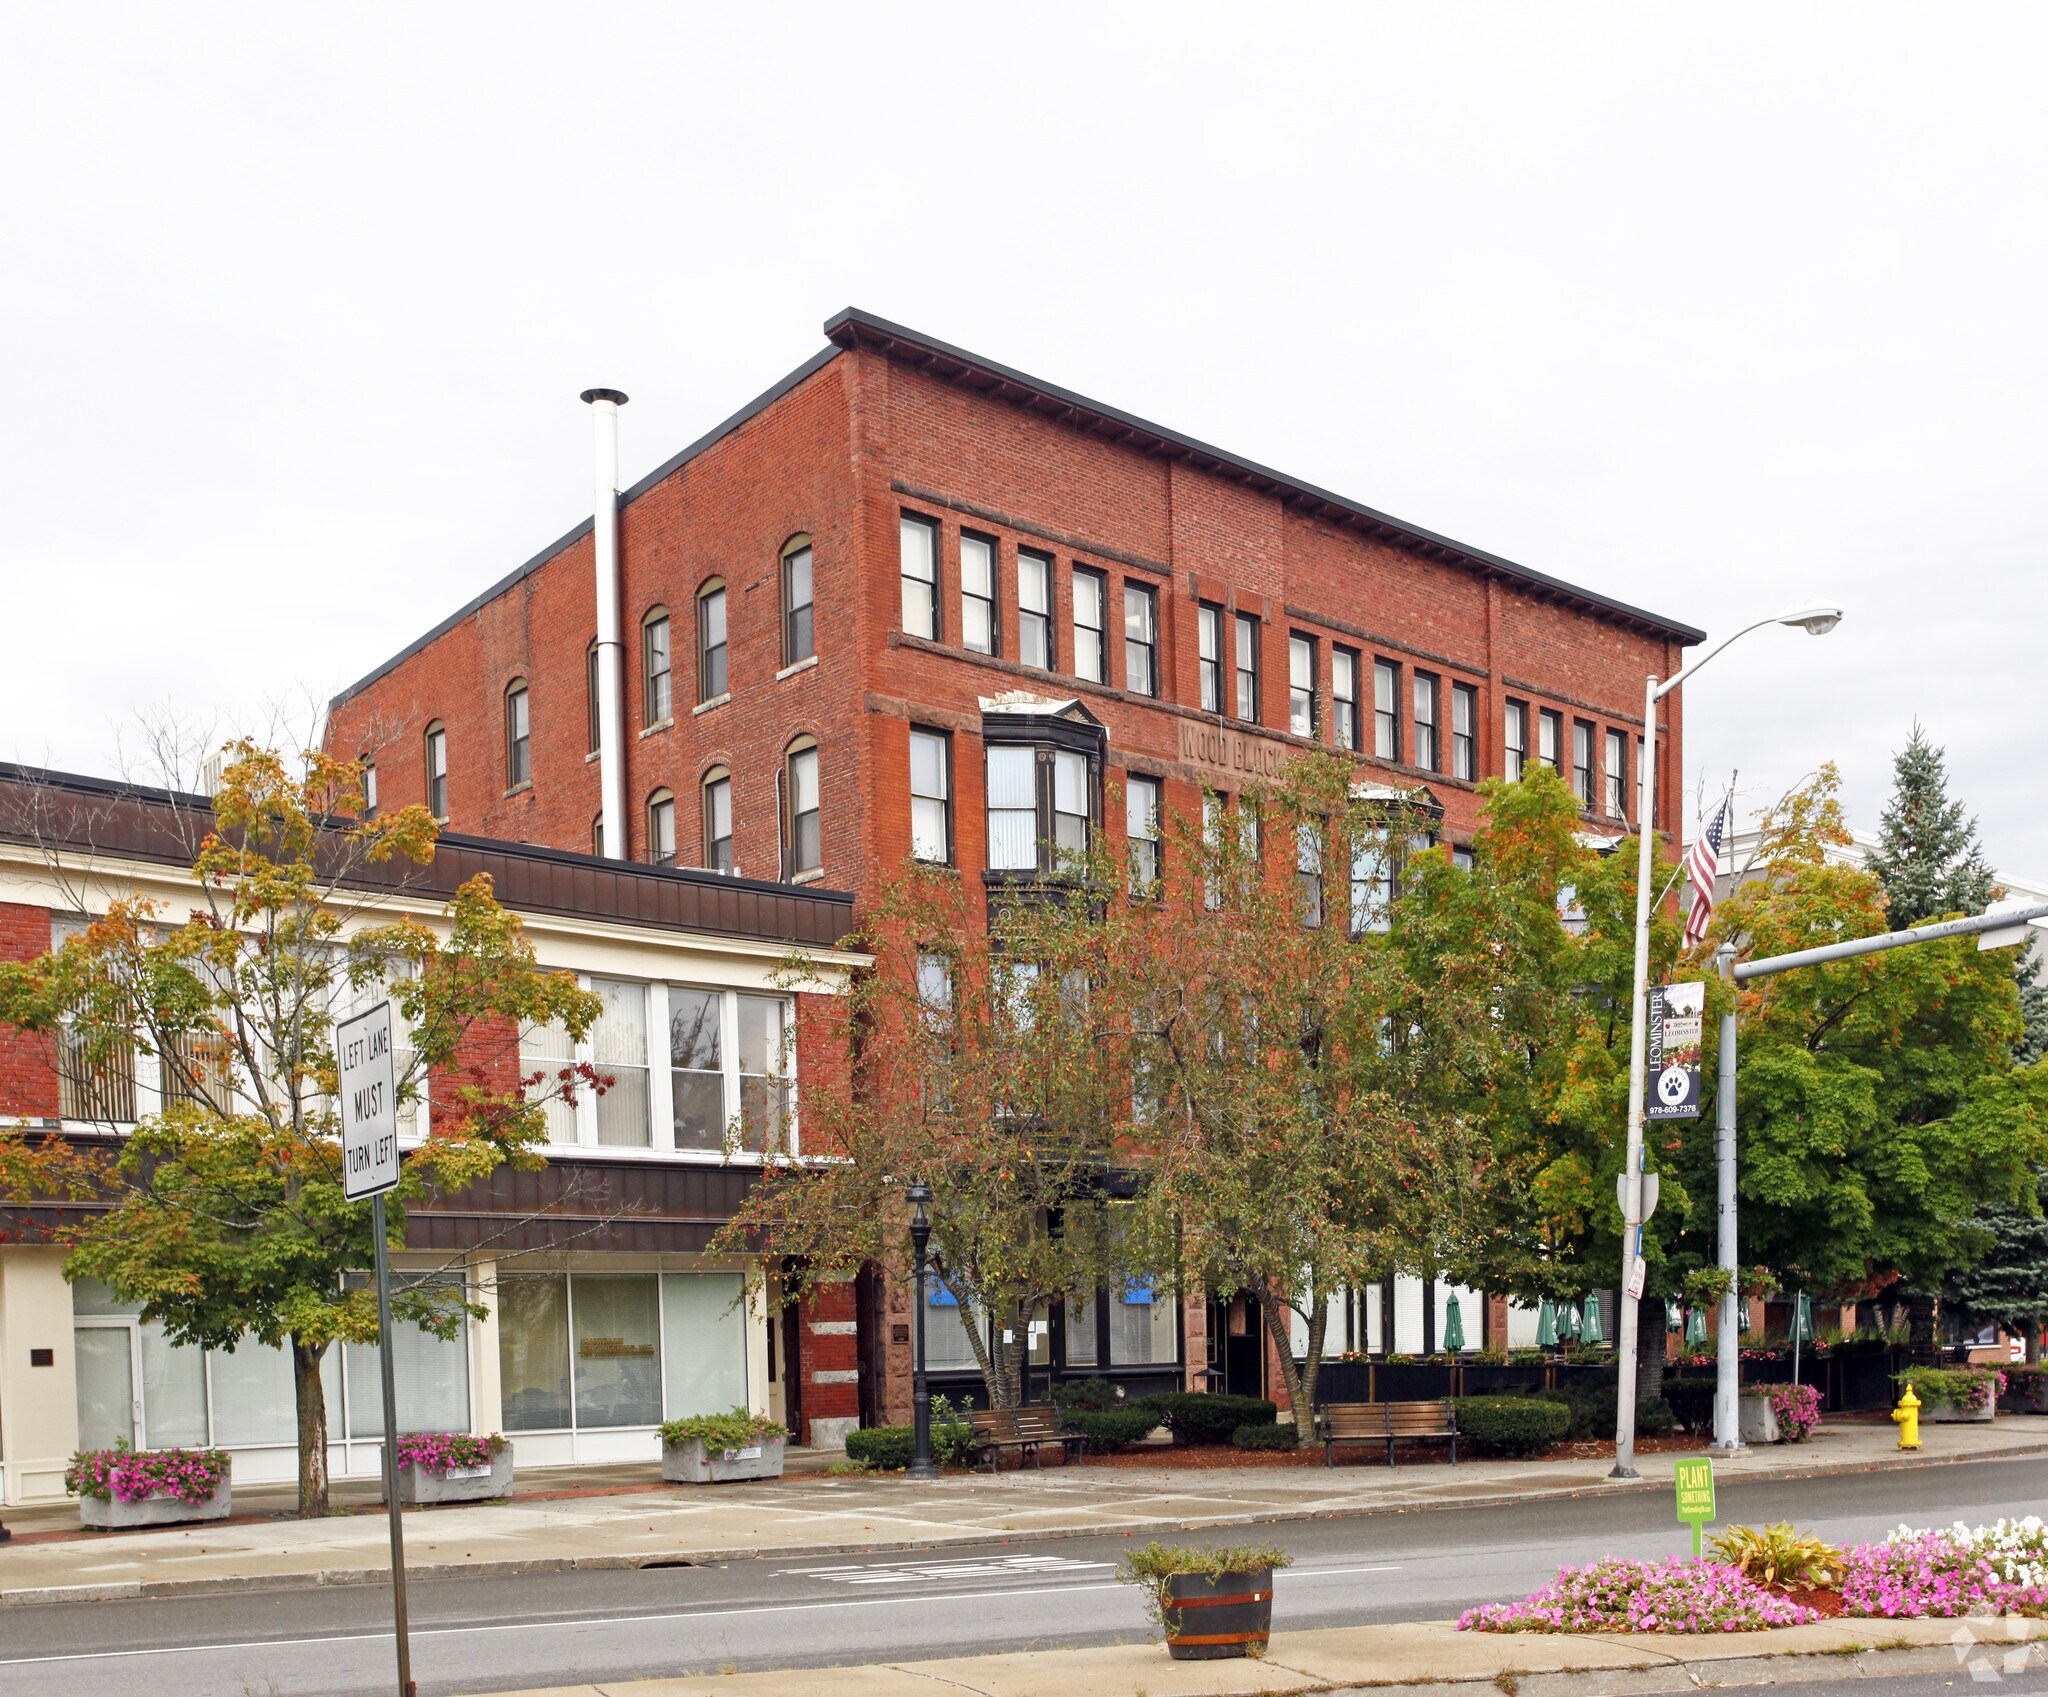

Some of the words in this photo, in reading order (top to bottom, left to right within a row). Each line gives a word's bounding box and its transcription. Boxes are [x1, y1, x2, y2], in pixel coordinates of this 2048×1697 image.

[1181, 725, 1227, 766] WOOD
[1233, 740, 1284, 780] BLOCK
[343, 1039, 364, 1071] LEFT
[368, 1026, 389, 1061] LANE
[1649, 992, 1663, 1072] LEOMINSTER
[1664, 1028, 1699, 1037] LEOMINSTER
[354, 1081, 383, 1124] MUST
[348, 1143, 371, 1175] TURN
[374, 1134, 393, 1168] LEFT
[1679, 1465, 1708, 1489] PLANT
